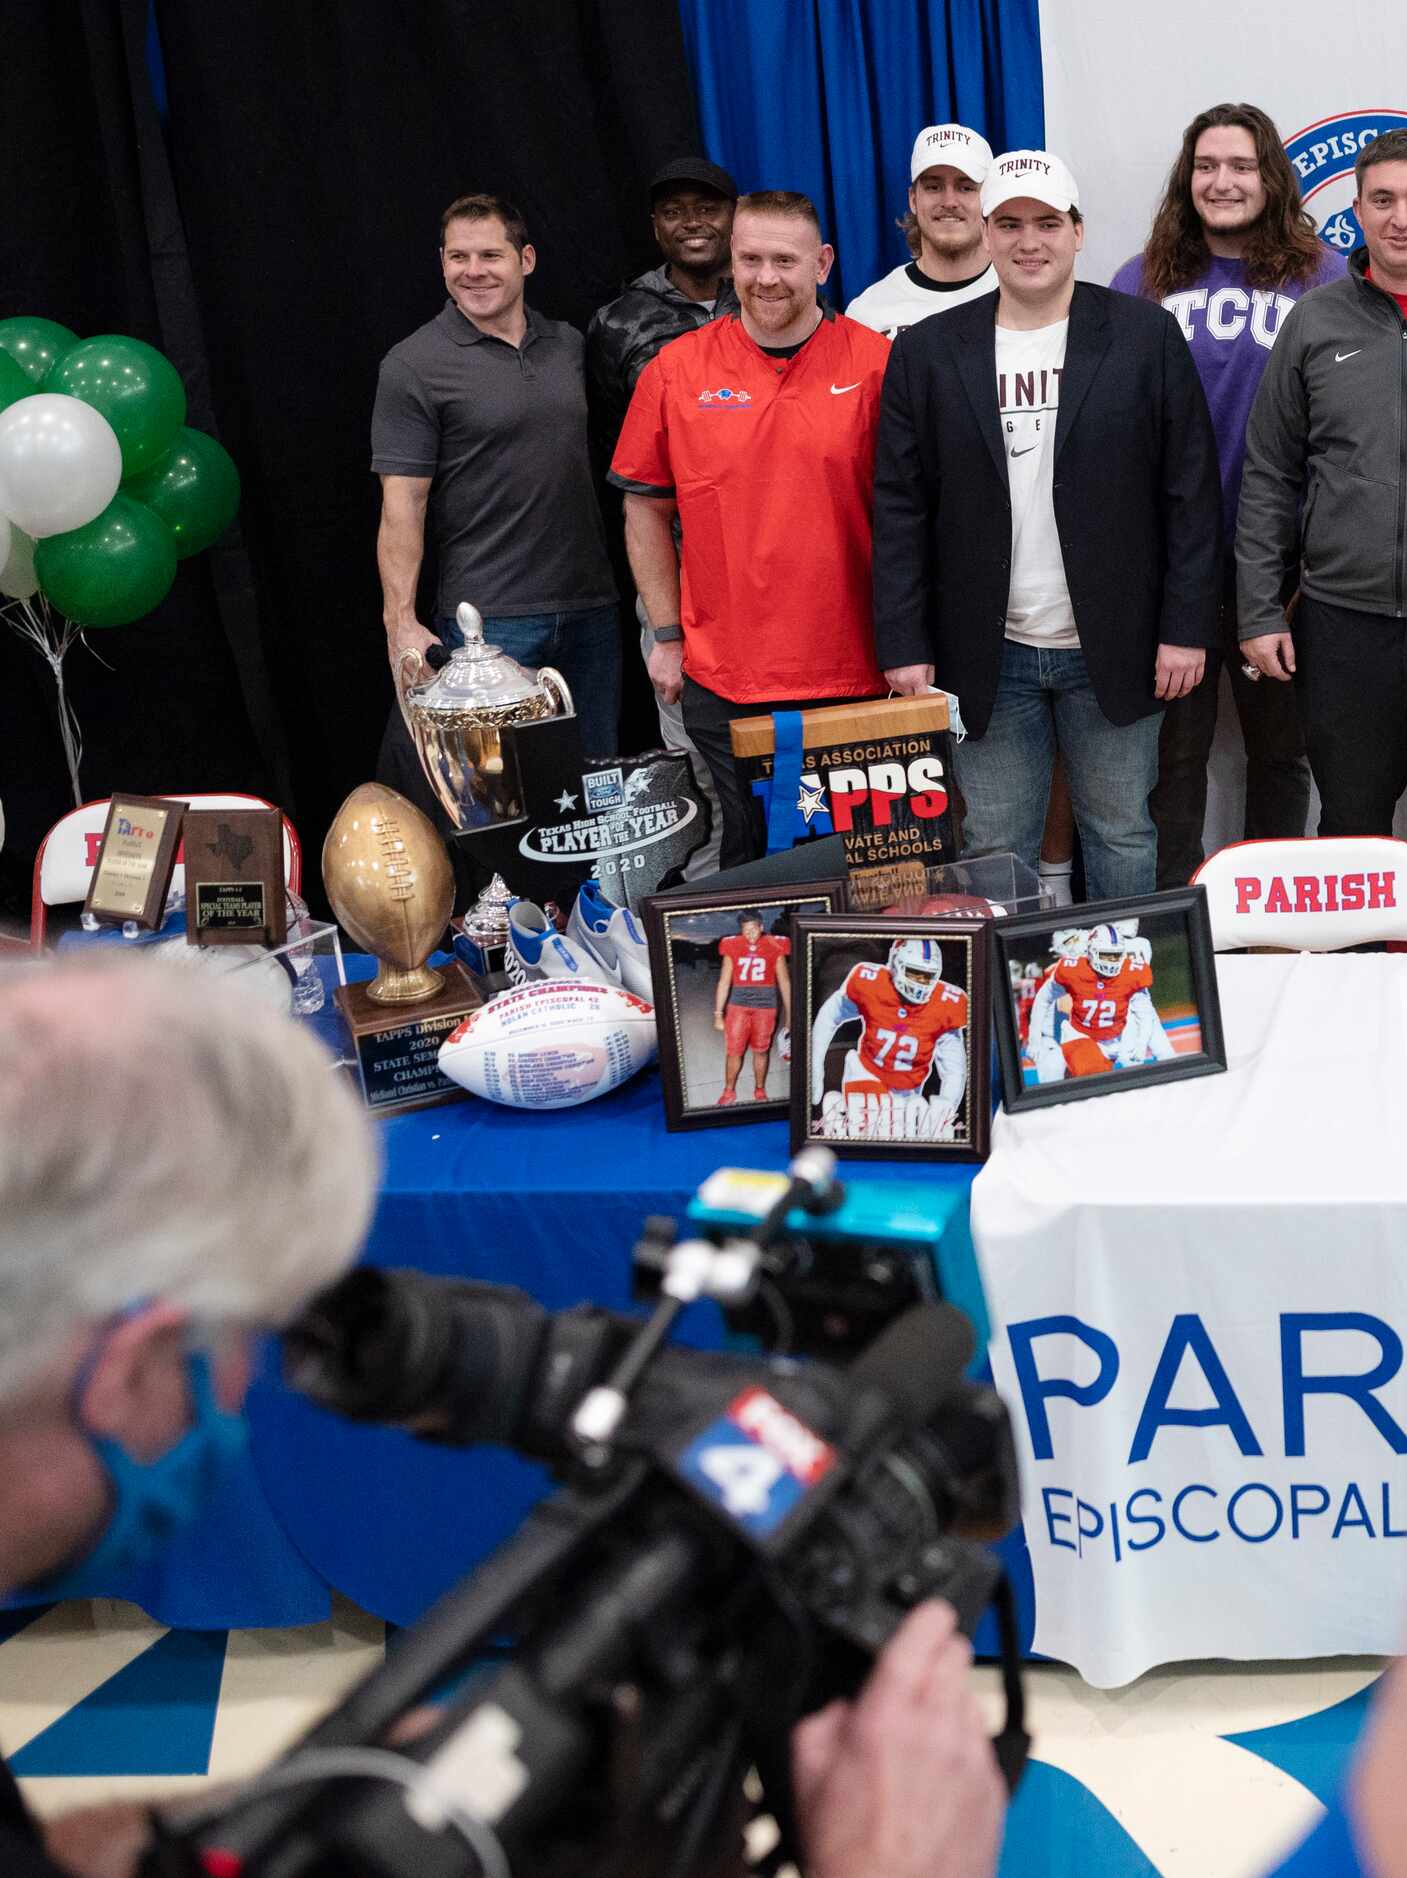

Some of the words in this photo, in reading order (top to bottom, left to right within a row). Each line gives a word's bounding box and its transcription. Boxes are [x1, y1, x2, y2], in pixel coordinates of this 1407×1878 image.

[926, 130, 971, 147] TRINITY
[999, 158, 1051, 176] TRINITY
[1161, 287, 1297, 350] TCU
[820, 739, 931, 767] ASSOCIATION
[587, 773, 618, 789] BUILT
[590, 795, 621, 809] TOUGH
[538, 825, 572, 838] TEXAS
[572, 818, 596, 829] HIGH
[597, 810, 631, 824] SCHOOL
[632, 801, 678, 817] FOOTBALL
[612, 821, 625, 833] OF
[628, 809, 679, 838] YEAR
[540, 824, 612, 852] PLAYER
[613, 831, 630, 844] THE
[845, 833, 884, 850] VATE
[888, 827, 921, 843] AND
[867, 838, 943, 861] SCHOOLS
[590, 854, 646, 879] 2020
[1234, 871, 1397, 914] PARISH
[738, 956, 766, 981] 72
[487, 994, 525, 1015] STATE
[528, 985, 609, 998] CHAMPIONS
[499, 1001, 531, 1019] PARISH
[533, 996, 584, 1009] EPISCOPAL
[1082, 999, 1117, 1028] 72
[375, 1027, 413, 1043] TAPPS
[415, 1016, 462, 1034] Division
[409, 1036, 440, 1050] 2020
[873, 1027, 919, 1071] 72
[373, 1056, 411, 1073] STATE
[393, 1064, 440, 1082] CHAMPI
